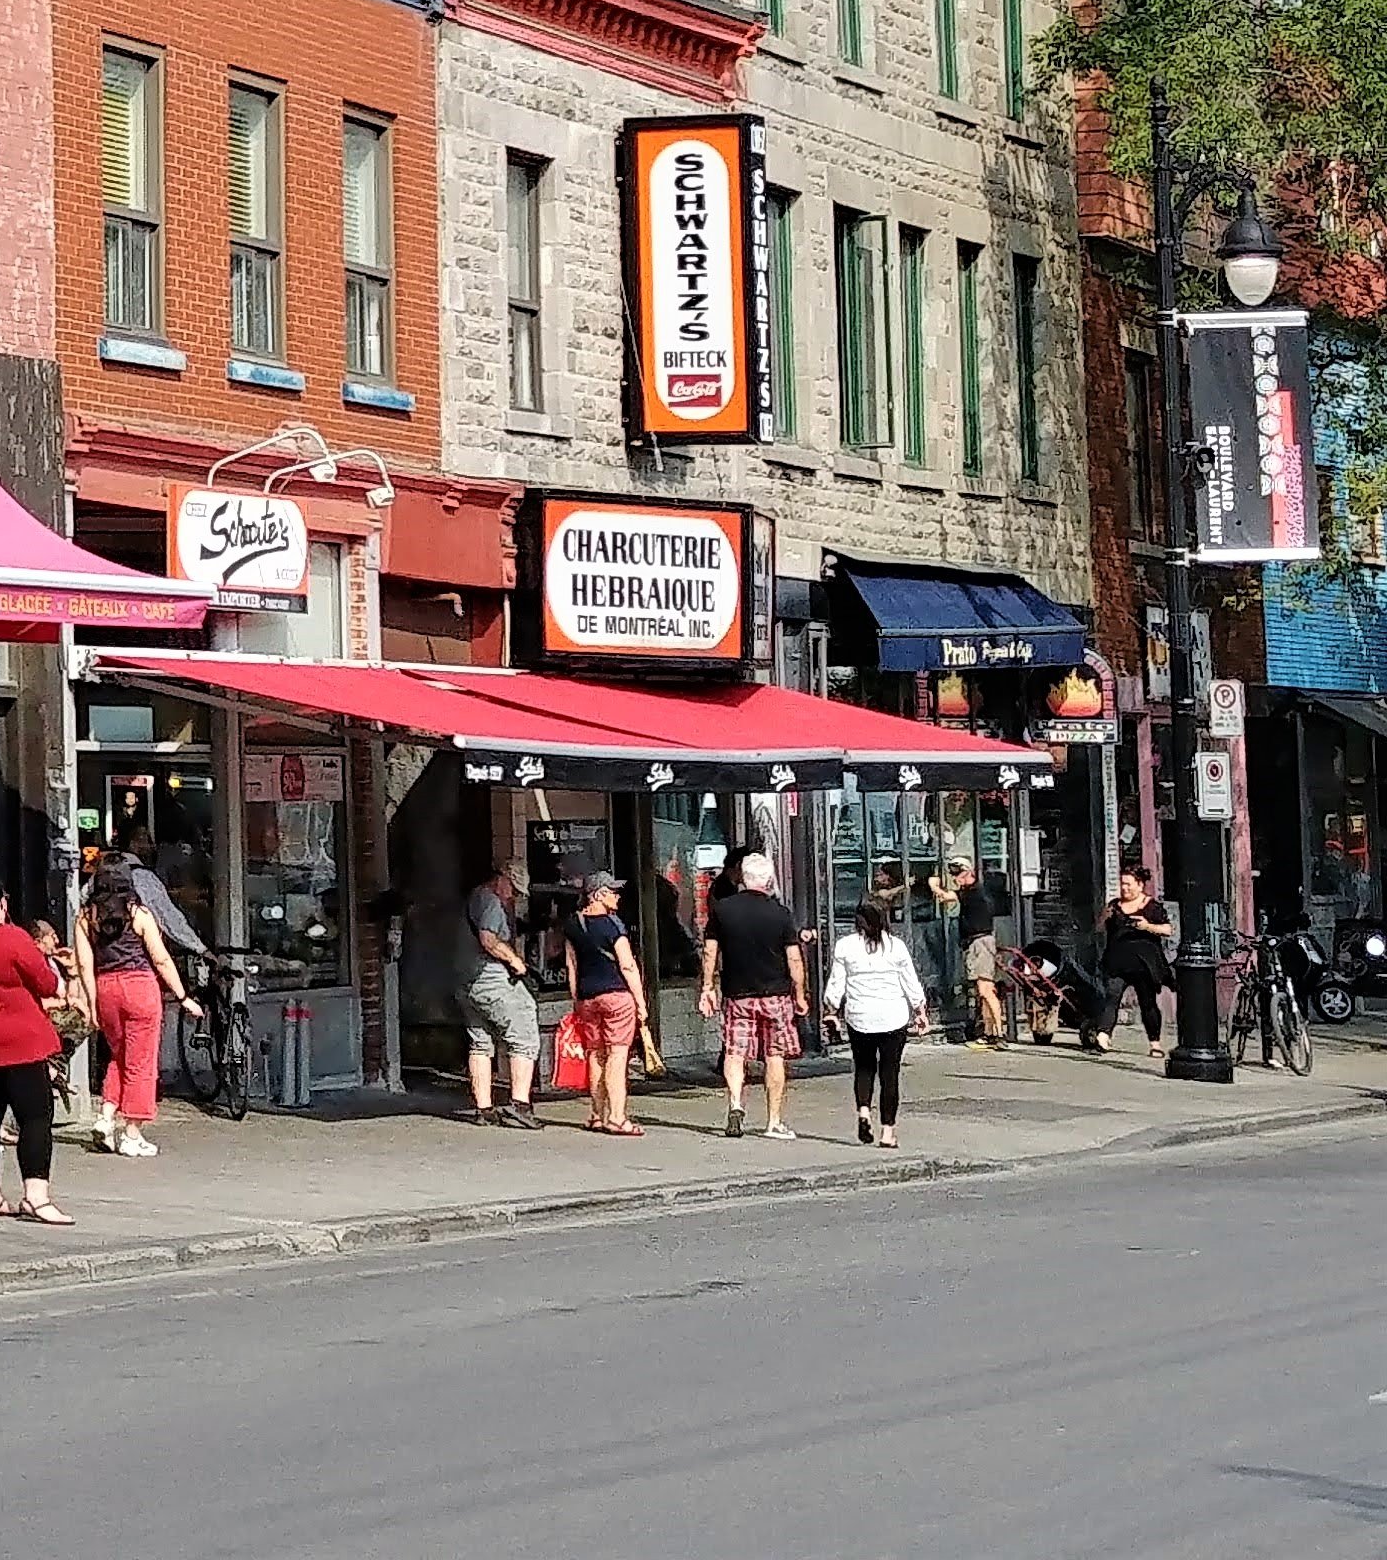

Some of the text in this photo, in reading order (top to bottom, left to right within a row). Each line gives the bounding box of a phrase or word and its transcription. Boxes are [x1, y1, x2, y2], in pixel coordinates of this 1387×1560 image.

[673, 153, 710, 342] SCHWARTZ'S
[752, 168, 772, 408] SCHWARTZ'S
[663, 350, 727, 369] BIFTECK
[1205, 425, 1223, 545] SA-LAURENT
[1218, 425, 1234, 512] BOULEVARD
[563, 528, 721, 570] CHARCUTERIE
[571, 573, 716, 618] HEBRAIQUE
[577, 614, 715, 640] DE MONTRÉAL INC.
[941, 638, 977, 667] Prato
